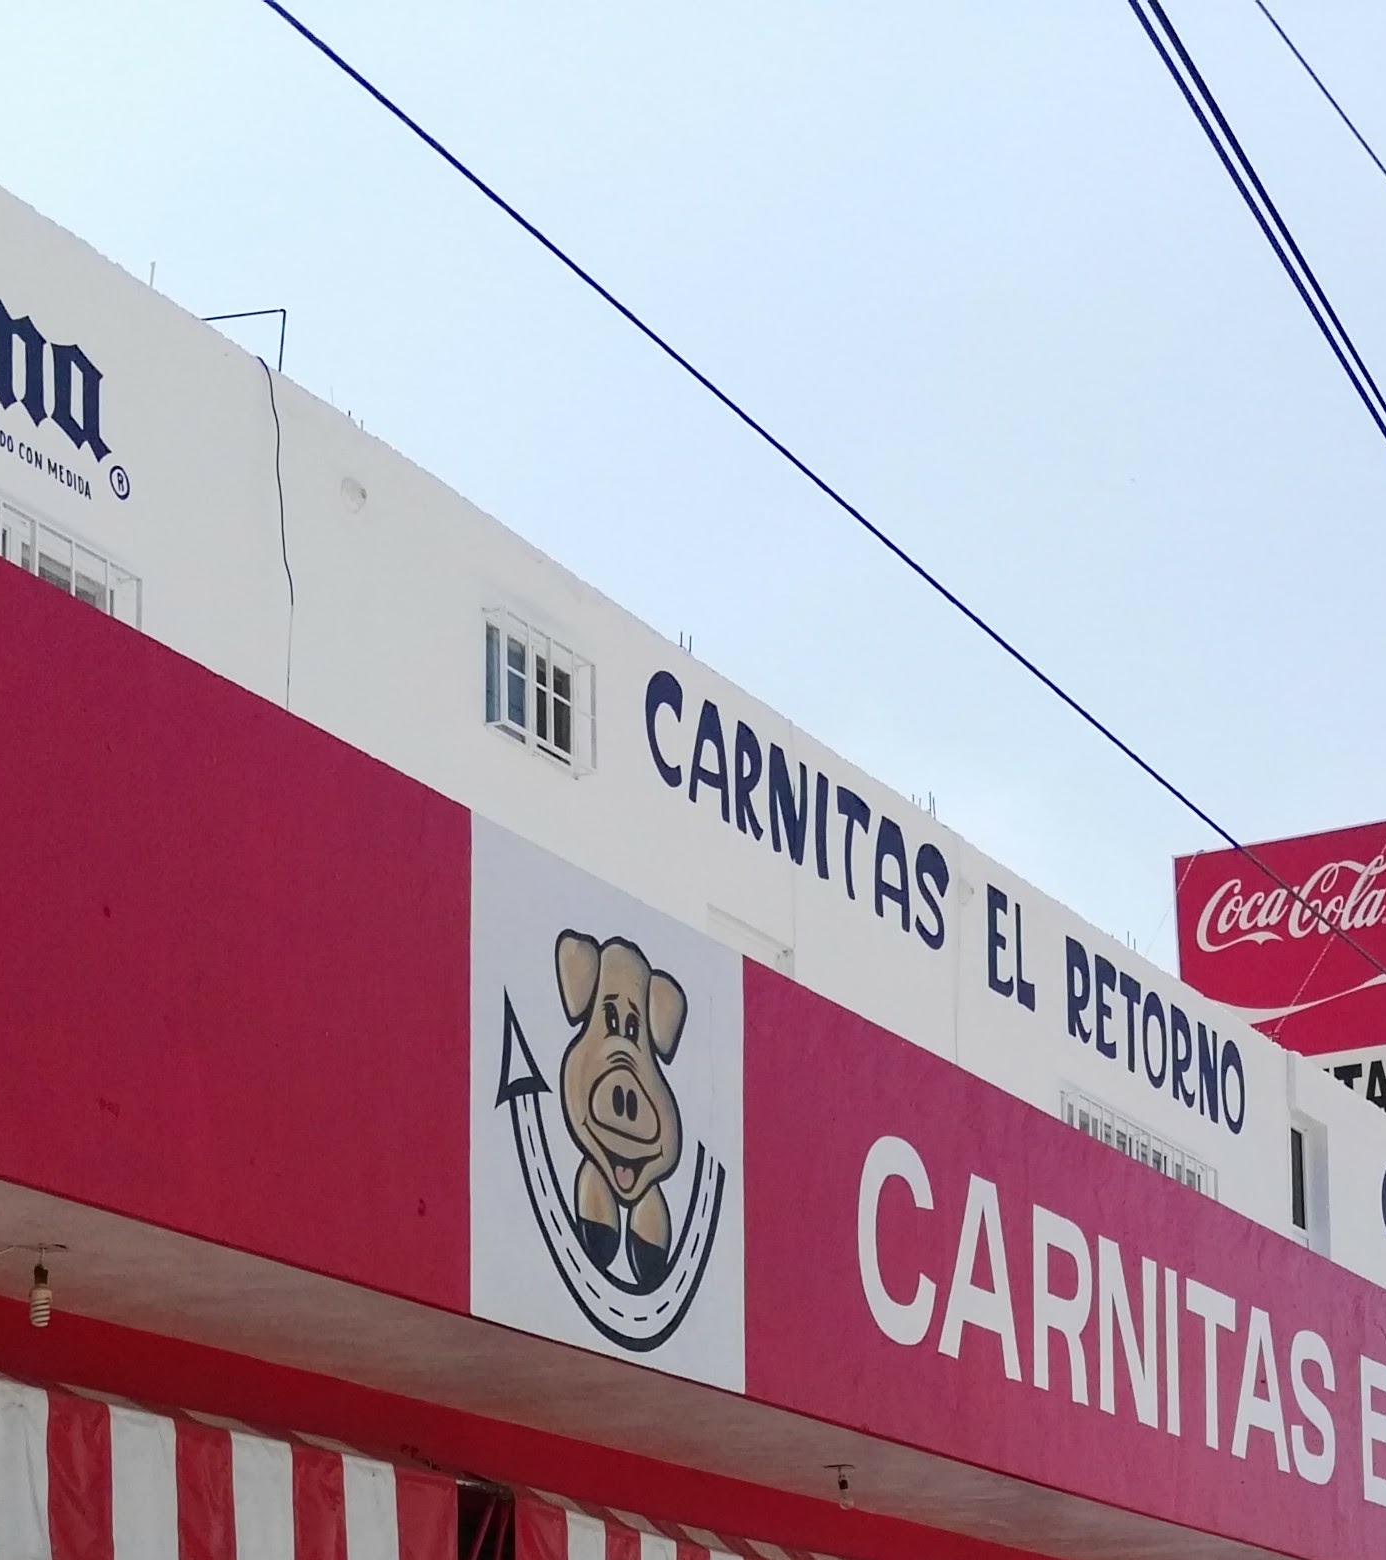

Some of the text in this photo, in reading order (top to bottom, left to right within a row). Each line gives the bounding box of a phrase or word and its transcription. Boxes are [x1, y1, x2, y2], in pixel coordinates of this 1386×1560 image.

[19, 442, 43, 471] CON
[48, 458, 91, 499] MEDIDA
[646, 671, 1245, 1135] CARNITAS EL RETORNO
[858, 1136, 1337, 1487] CARNITAS
